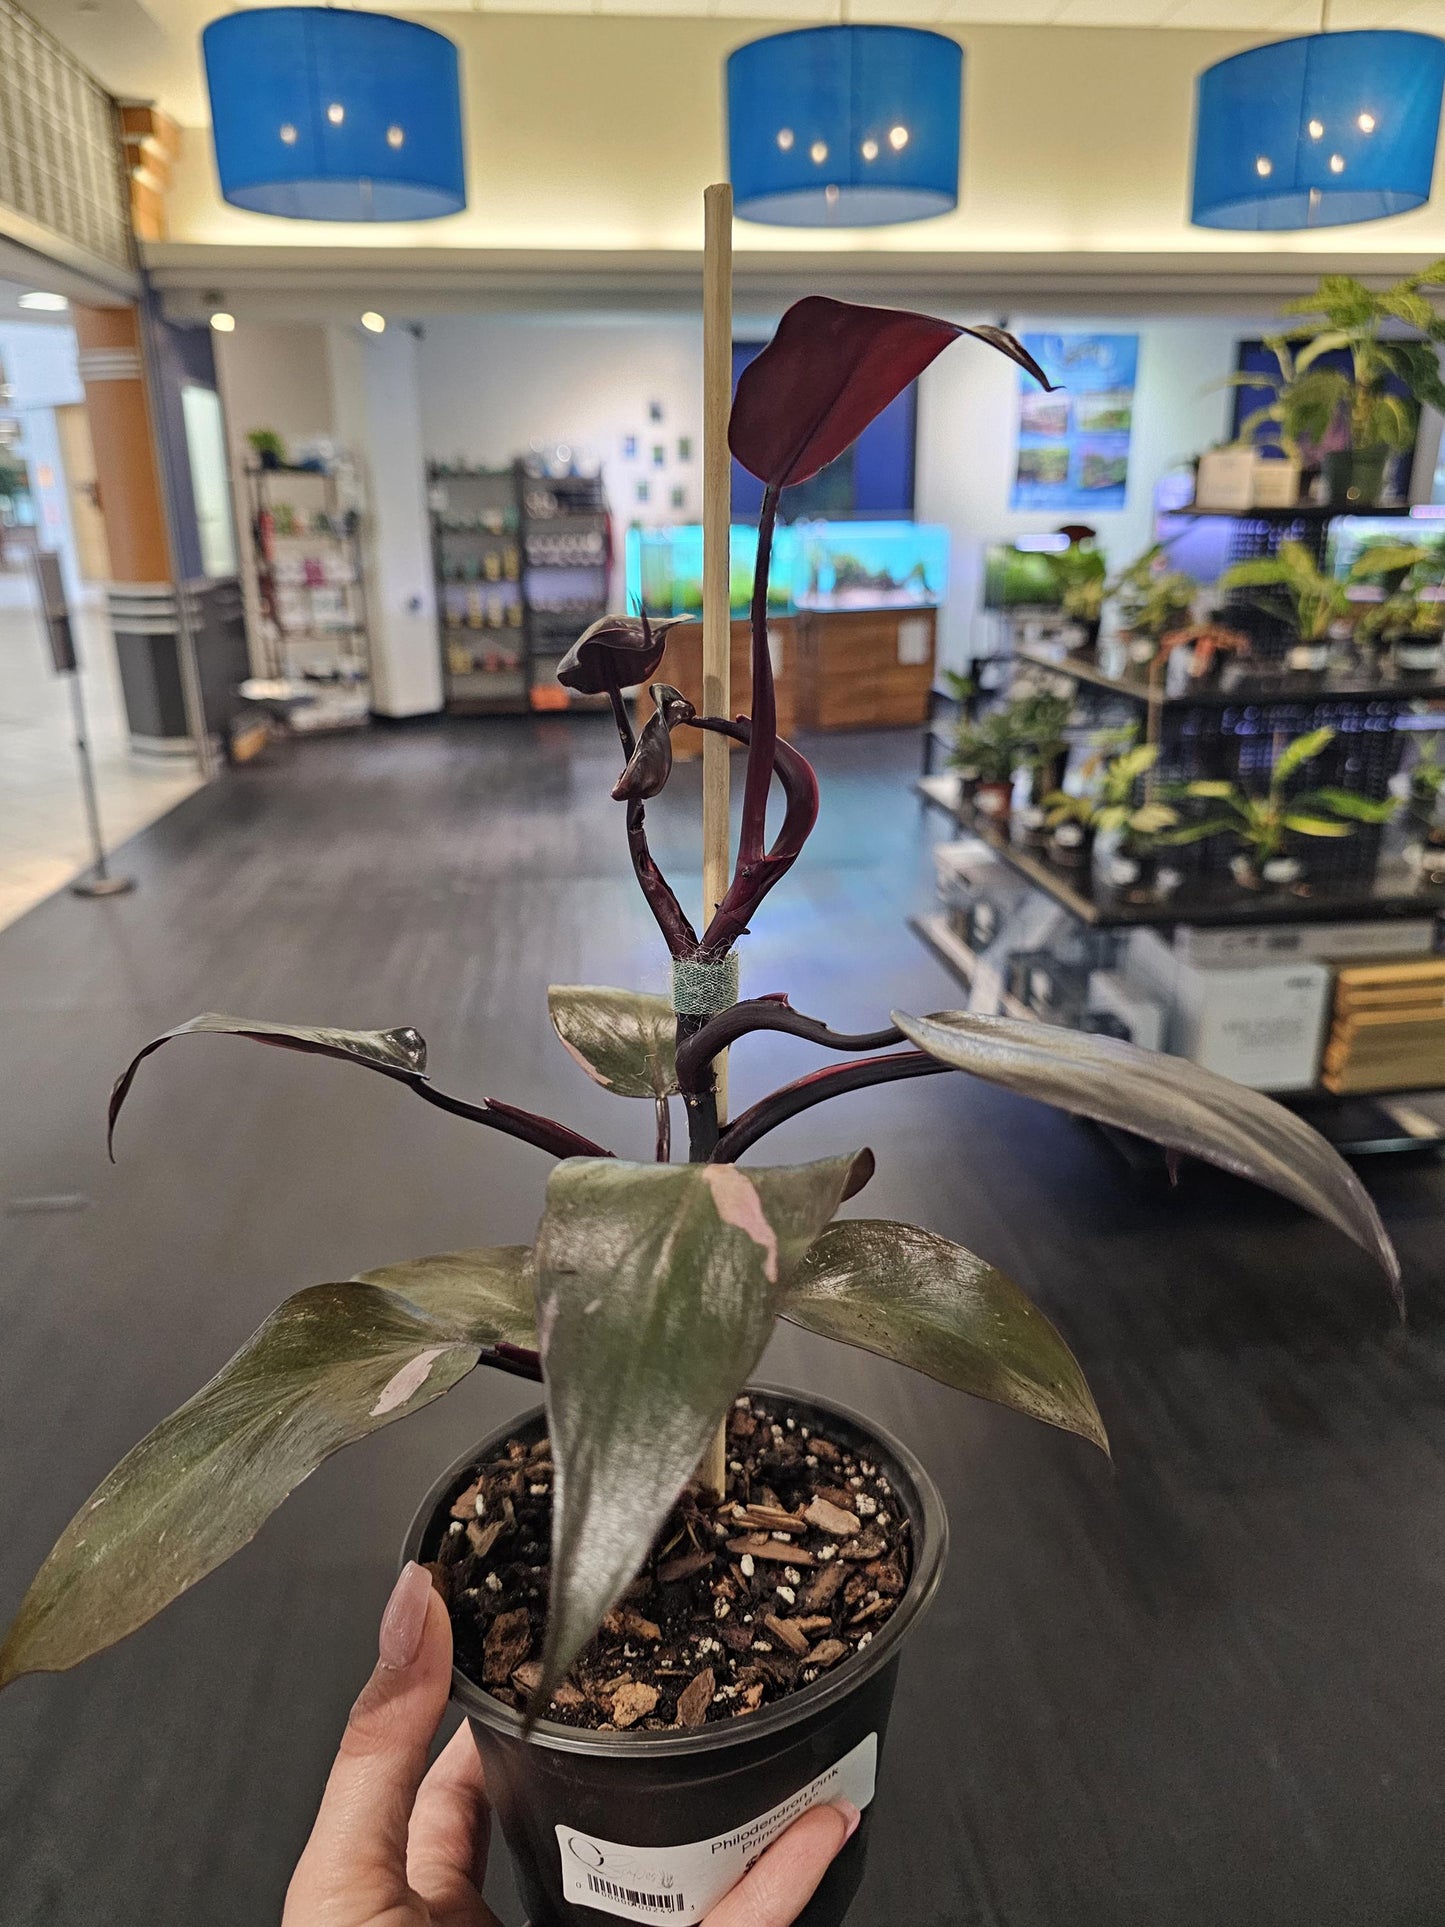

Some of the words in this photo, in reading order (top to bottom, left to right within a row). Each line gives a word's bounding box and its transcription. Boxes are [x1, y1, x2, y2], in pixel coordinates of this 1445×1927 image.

[711, 1791, 808, 1854] Philodendron
[811, 1767, 839, 1793] Pink
[741, 1808, 801, 1854] Princess
